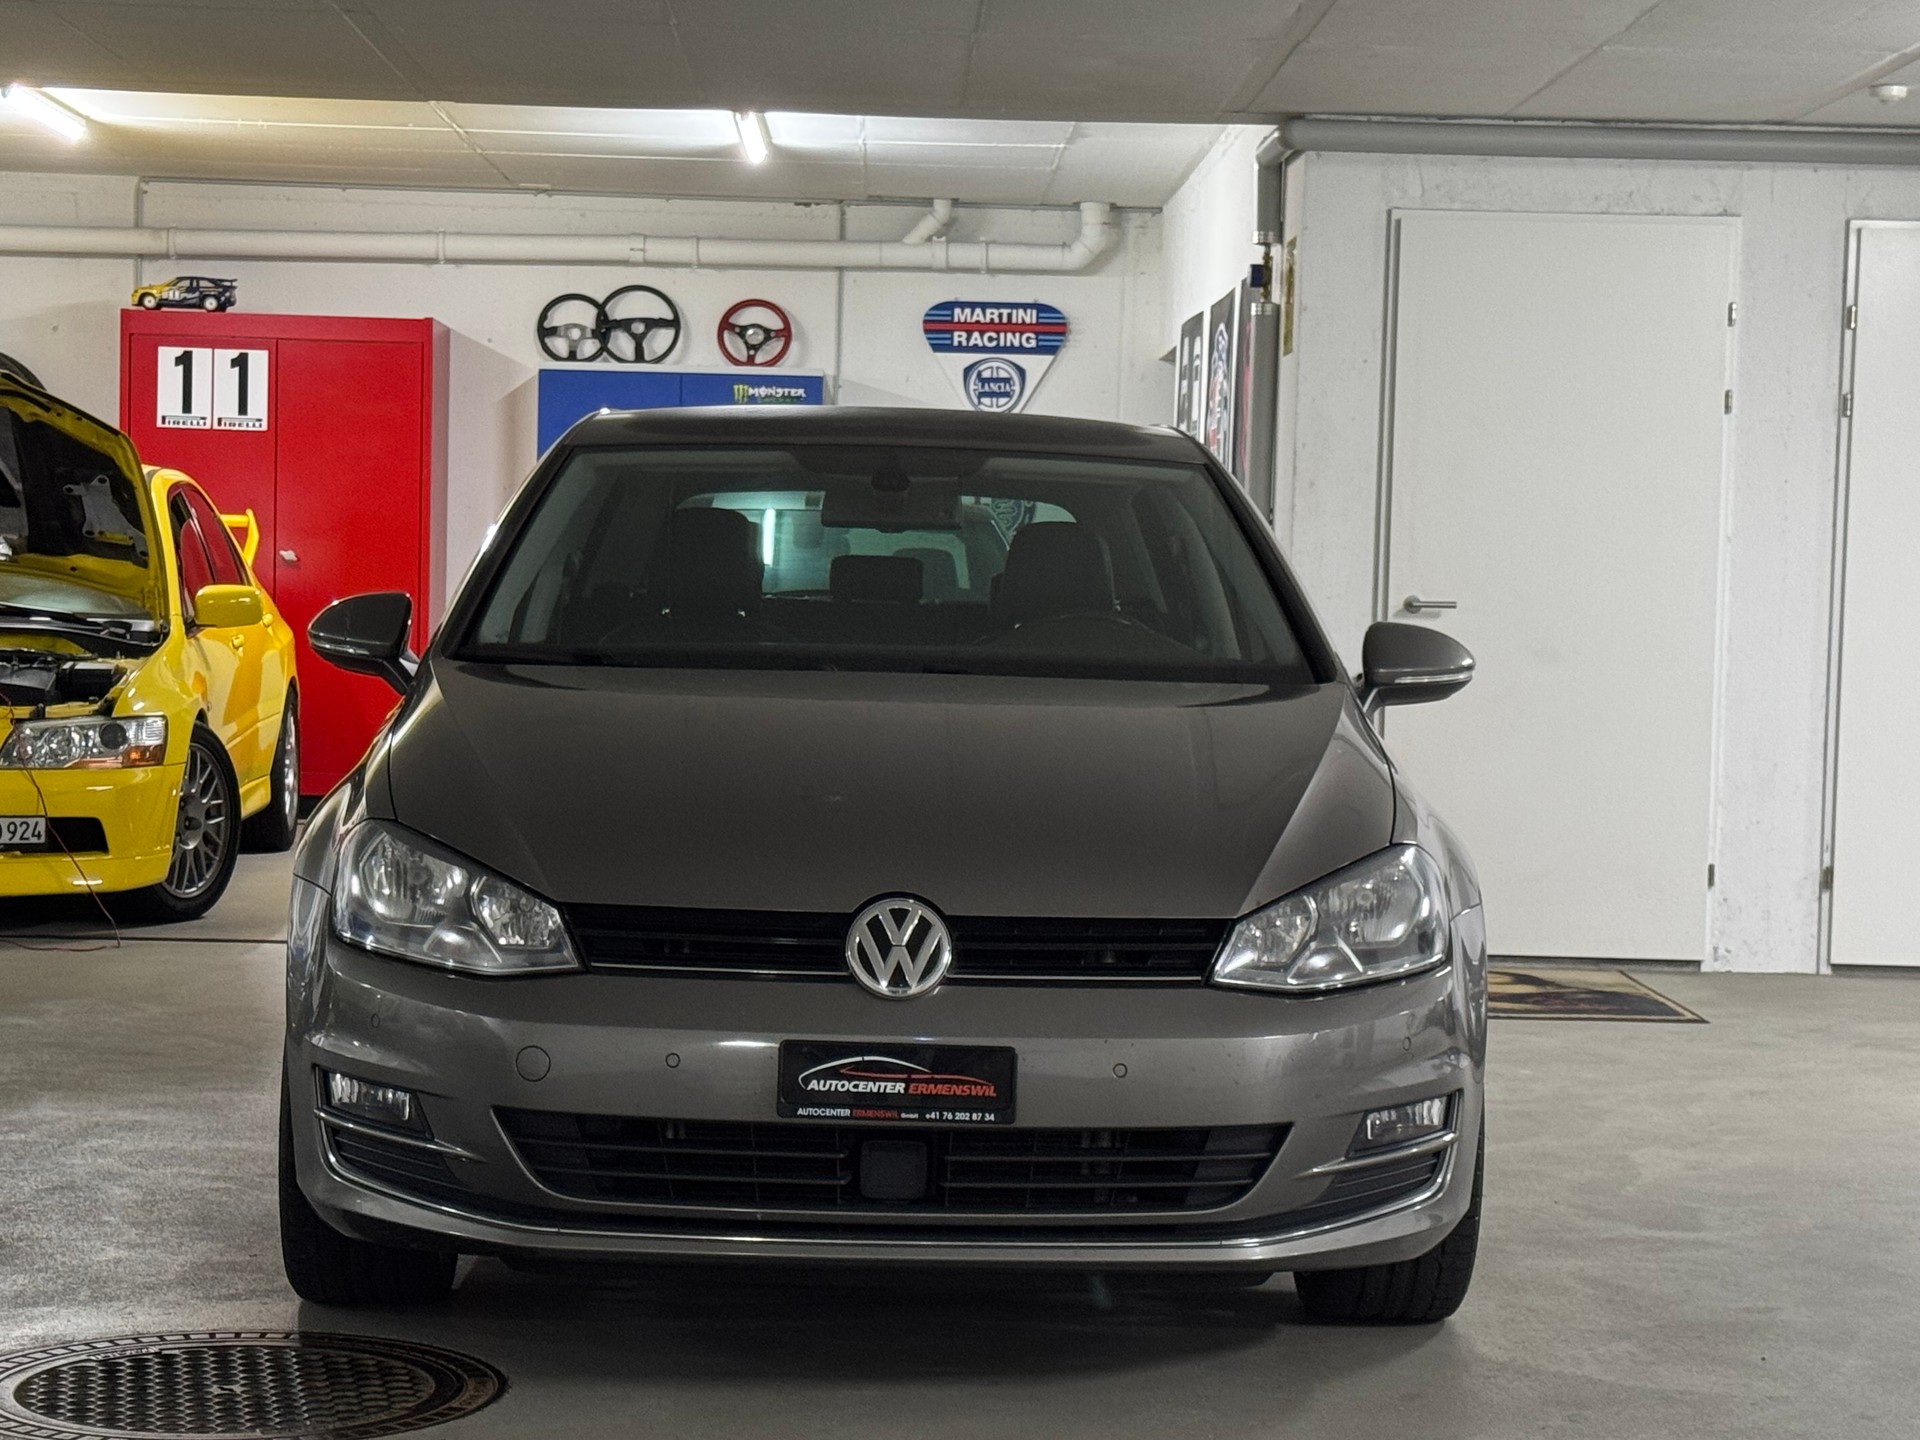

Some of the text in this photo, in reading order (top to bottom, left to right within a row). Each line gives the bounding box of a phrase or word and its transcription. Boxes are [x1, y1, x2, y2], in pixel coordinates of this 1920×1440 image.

[953, 307, 1038, 324] MARTINI
[952, 331, 1037, 348] RACING
[748, 385, 807, 398] MONSTER
[978, 382, 1011, 393] LANCIA
[806, 1080, 905, 1094] AUTOCENTER
[797, 1107, 851, 1117] AUTOCENTER
[925, 1111, 940, 1120] +41
[942, 1111, 953, 1120] 76
[955, 1112, 970, 1121] 202
[972, 1112, 982, 1121] 87
[984, 1113, 995, 1122] 34
